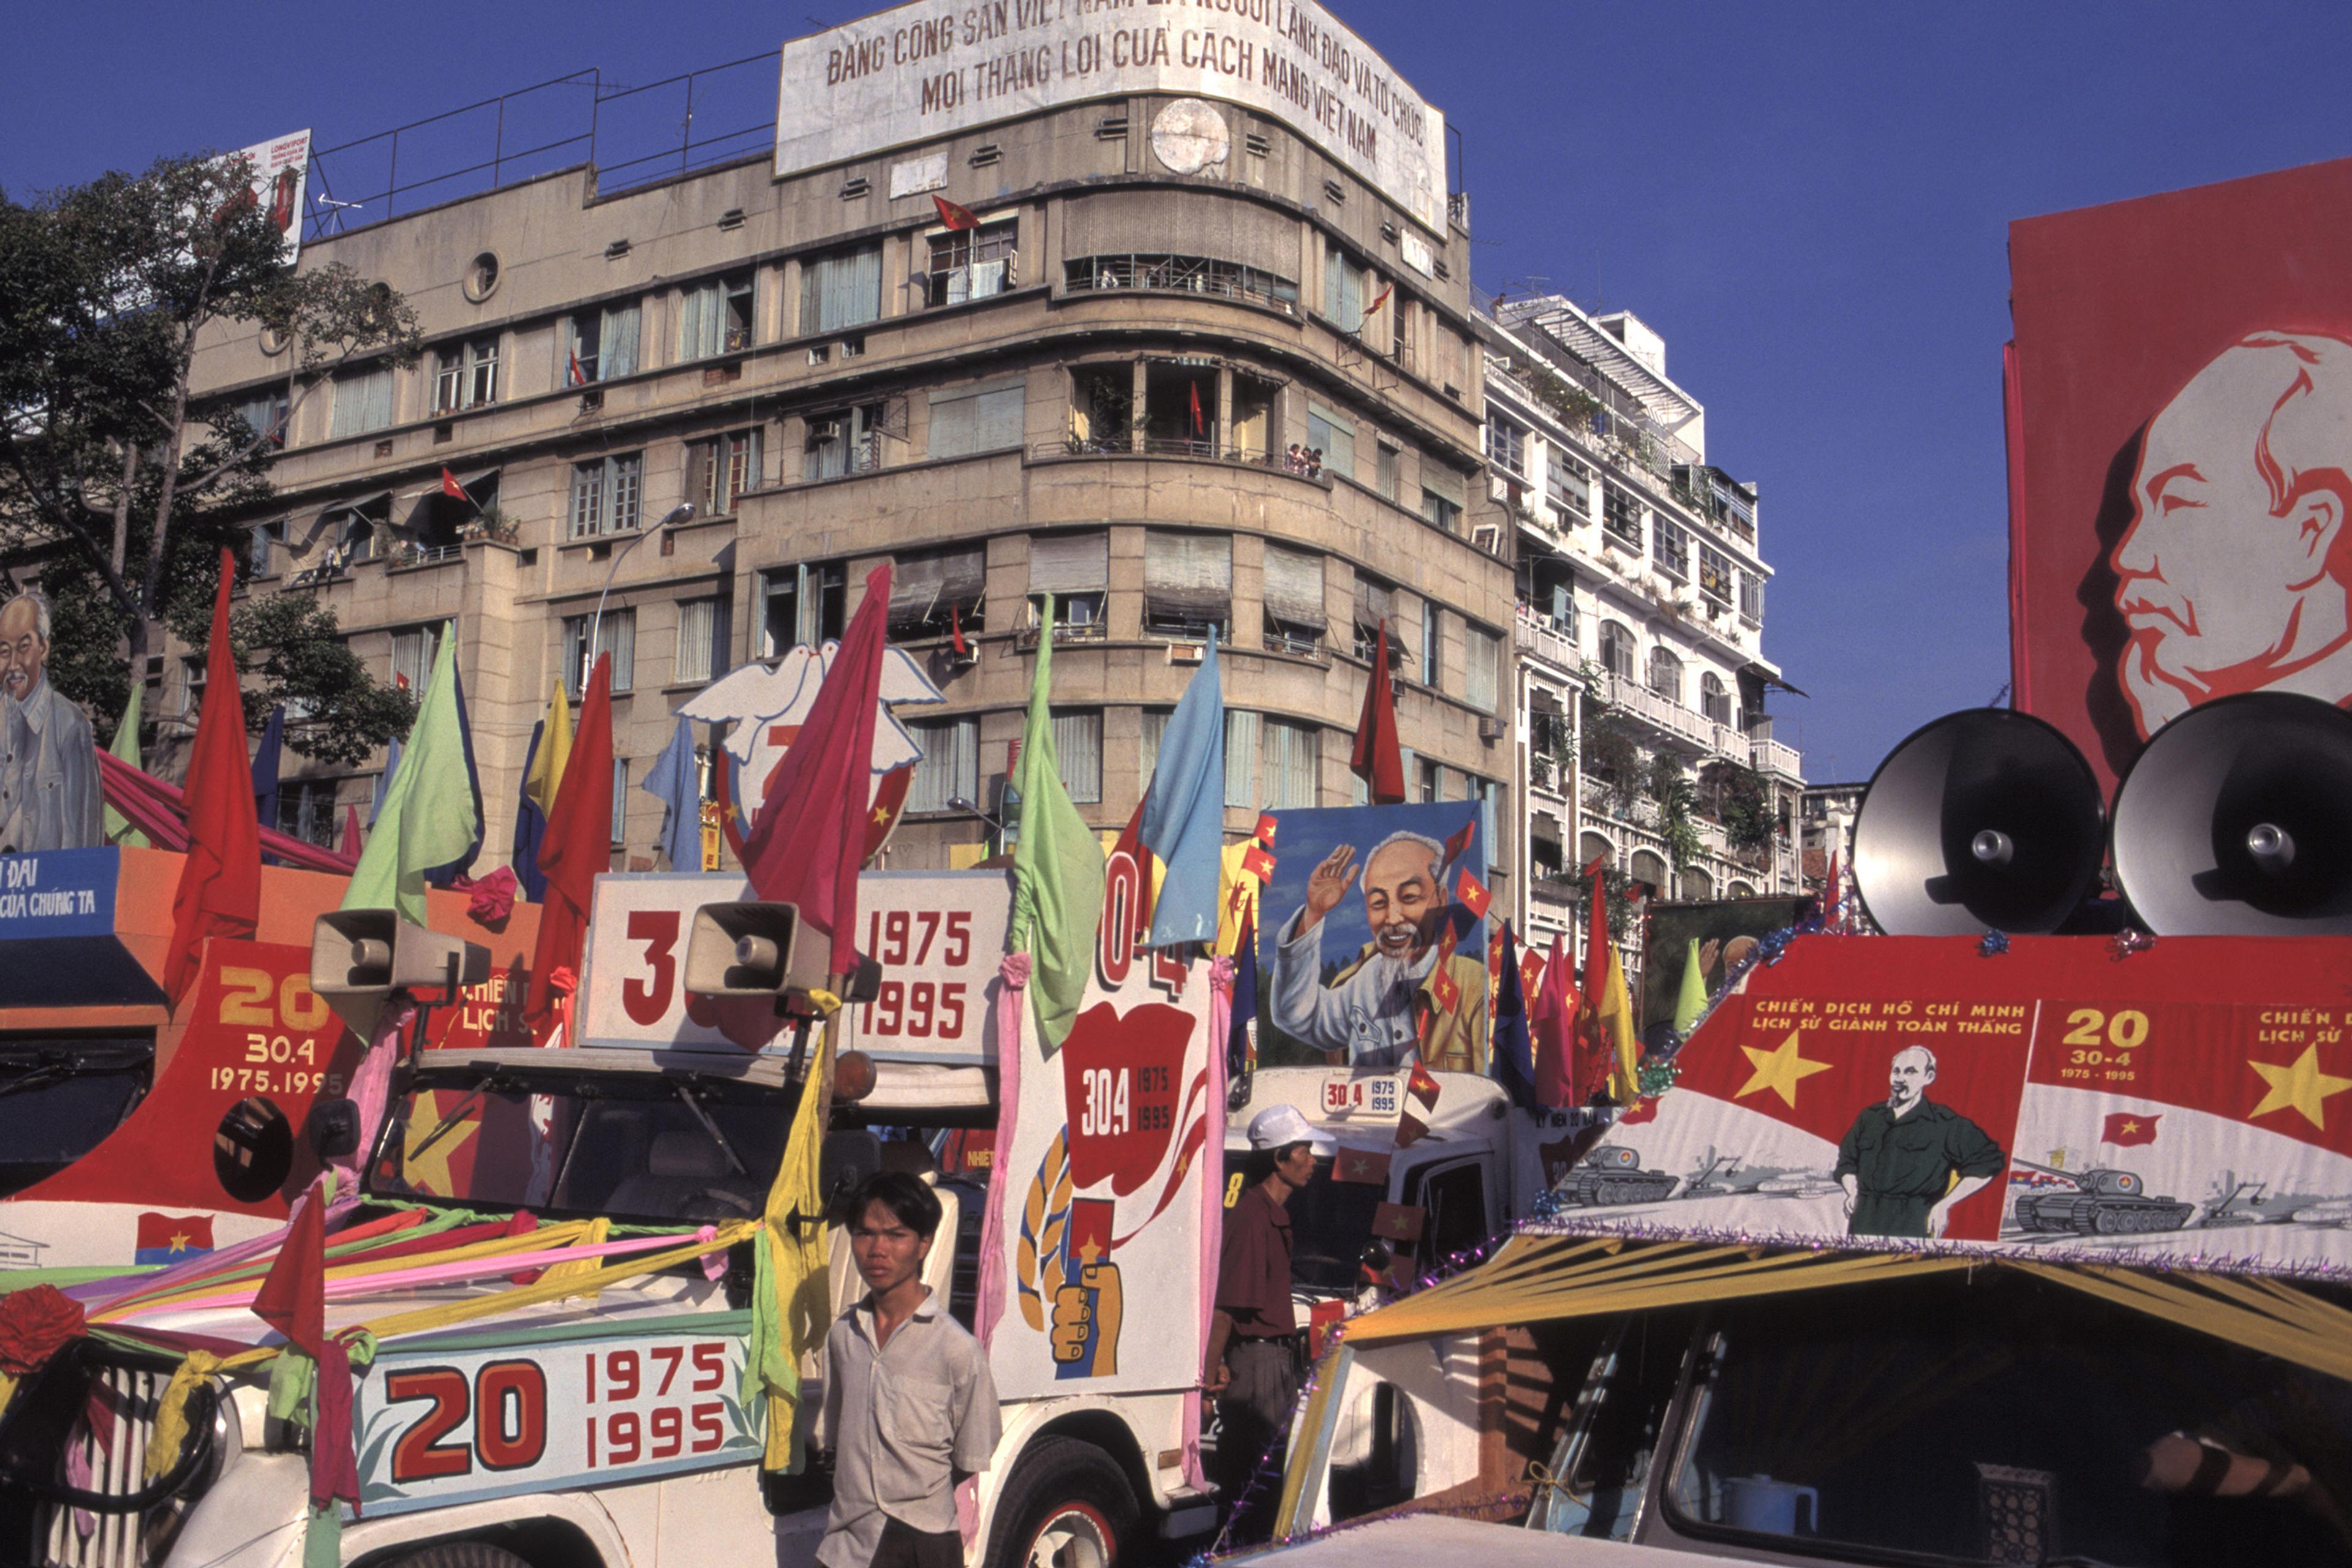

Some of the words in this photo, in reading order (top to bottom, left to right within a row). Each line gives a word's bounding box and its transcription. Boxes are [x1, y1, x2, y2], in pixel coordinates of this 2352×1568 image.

[1348, 108, 1376, 164] NAM
[30, 887, 75, 916] CHÚNG
[78, 890, 95, 914] TA
[219, 965, 330, 1031] 20
[1756, 998, 1814, 1013] CHIẾN
[1825, 1003, 1871, 1017] DỊCH
[1882, 1000, 1913, 1015] HỒ
[1925, 1001, 1960, 1016] CHÍ
[1970, 1005, 2025, 1017] MINH
[1752, 1017, 1791, 1031] LỊCH
[1828, 1017, 1887, 1031] GIÀNH
[1896, 1018, 1948, 1033] TOÀN
[1958, 1019, 2022, 1035] THẮNG
[2062, 1008, 2149, 1048] 20
[2260, 1008, 2330, 1025] CHIẾN
[245, 1033, 315, 1066] 30.4
[2259, 1029, 2305, 1044] LỊCH
[2070, 1049, 2131, 1066] 30-4
[1137, 1066, 1169, 1093] 1975
[2061, 1068, 2090, 1079] 1975
[2105, 1071, 2135, 1080] 1995
[1372, 1081, 1395, 1095] 1975
[1082, 1068, 1129, 1136] 30.4
[1372, 1097, 1395, 1110] 1995
[1137, 1105, 1170, 1131] 1995
[586, 1342, 726, 1404] 1975
[385, 1359, 548, 1483] 20
[586, 1401, 725, 1468] 1995
